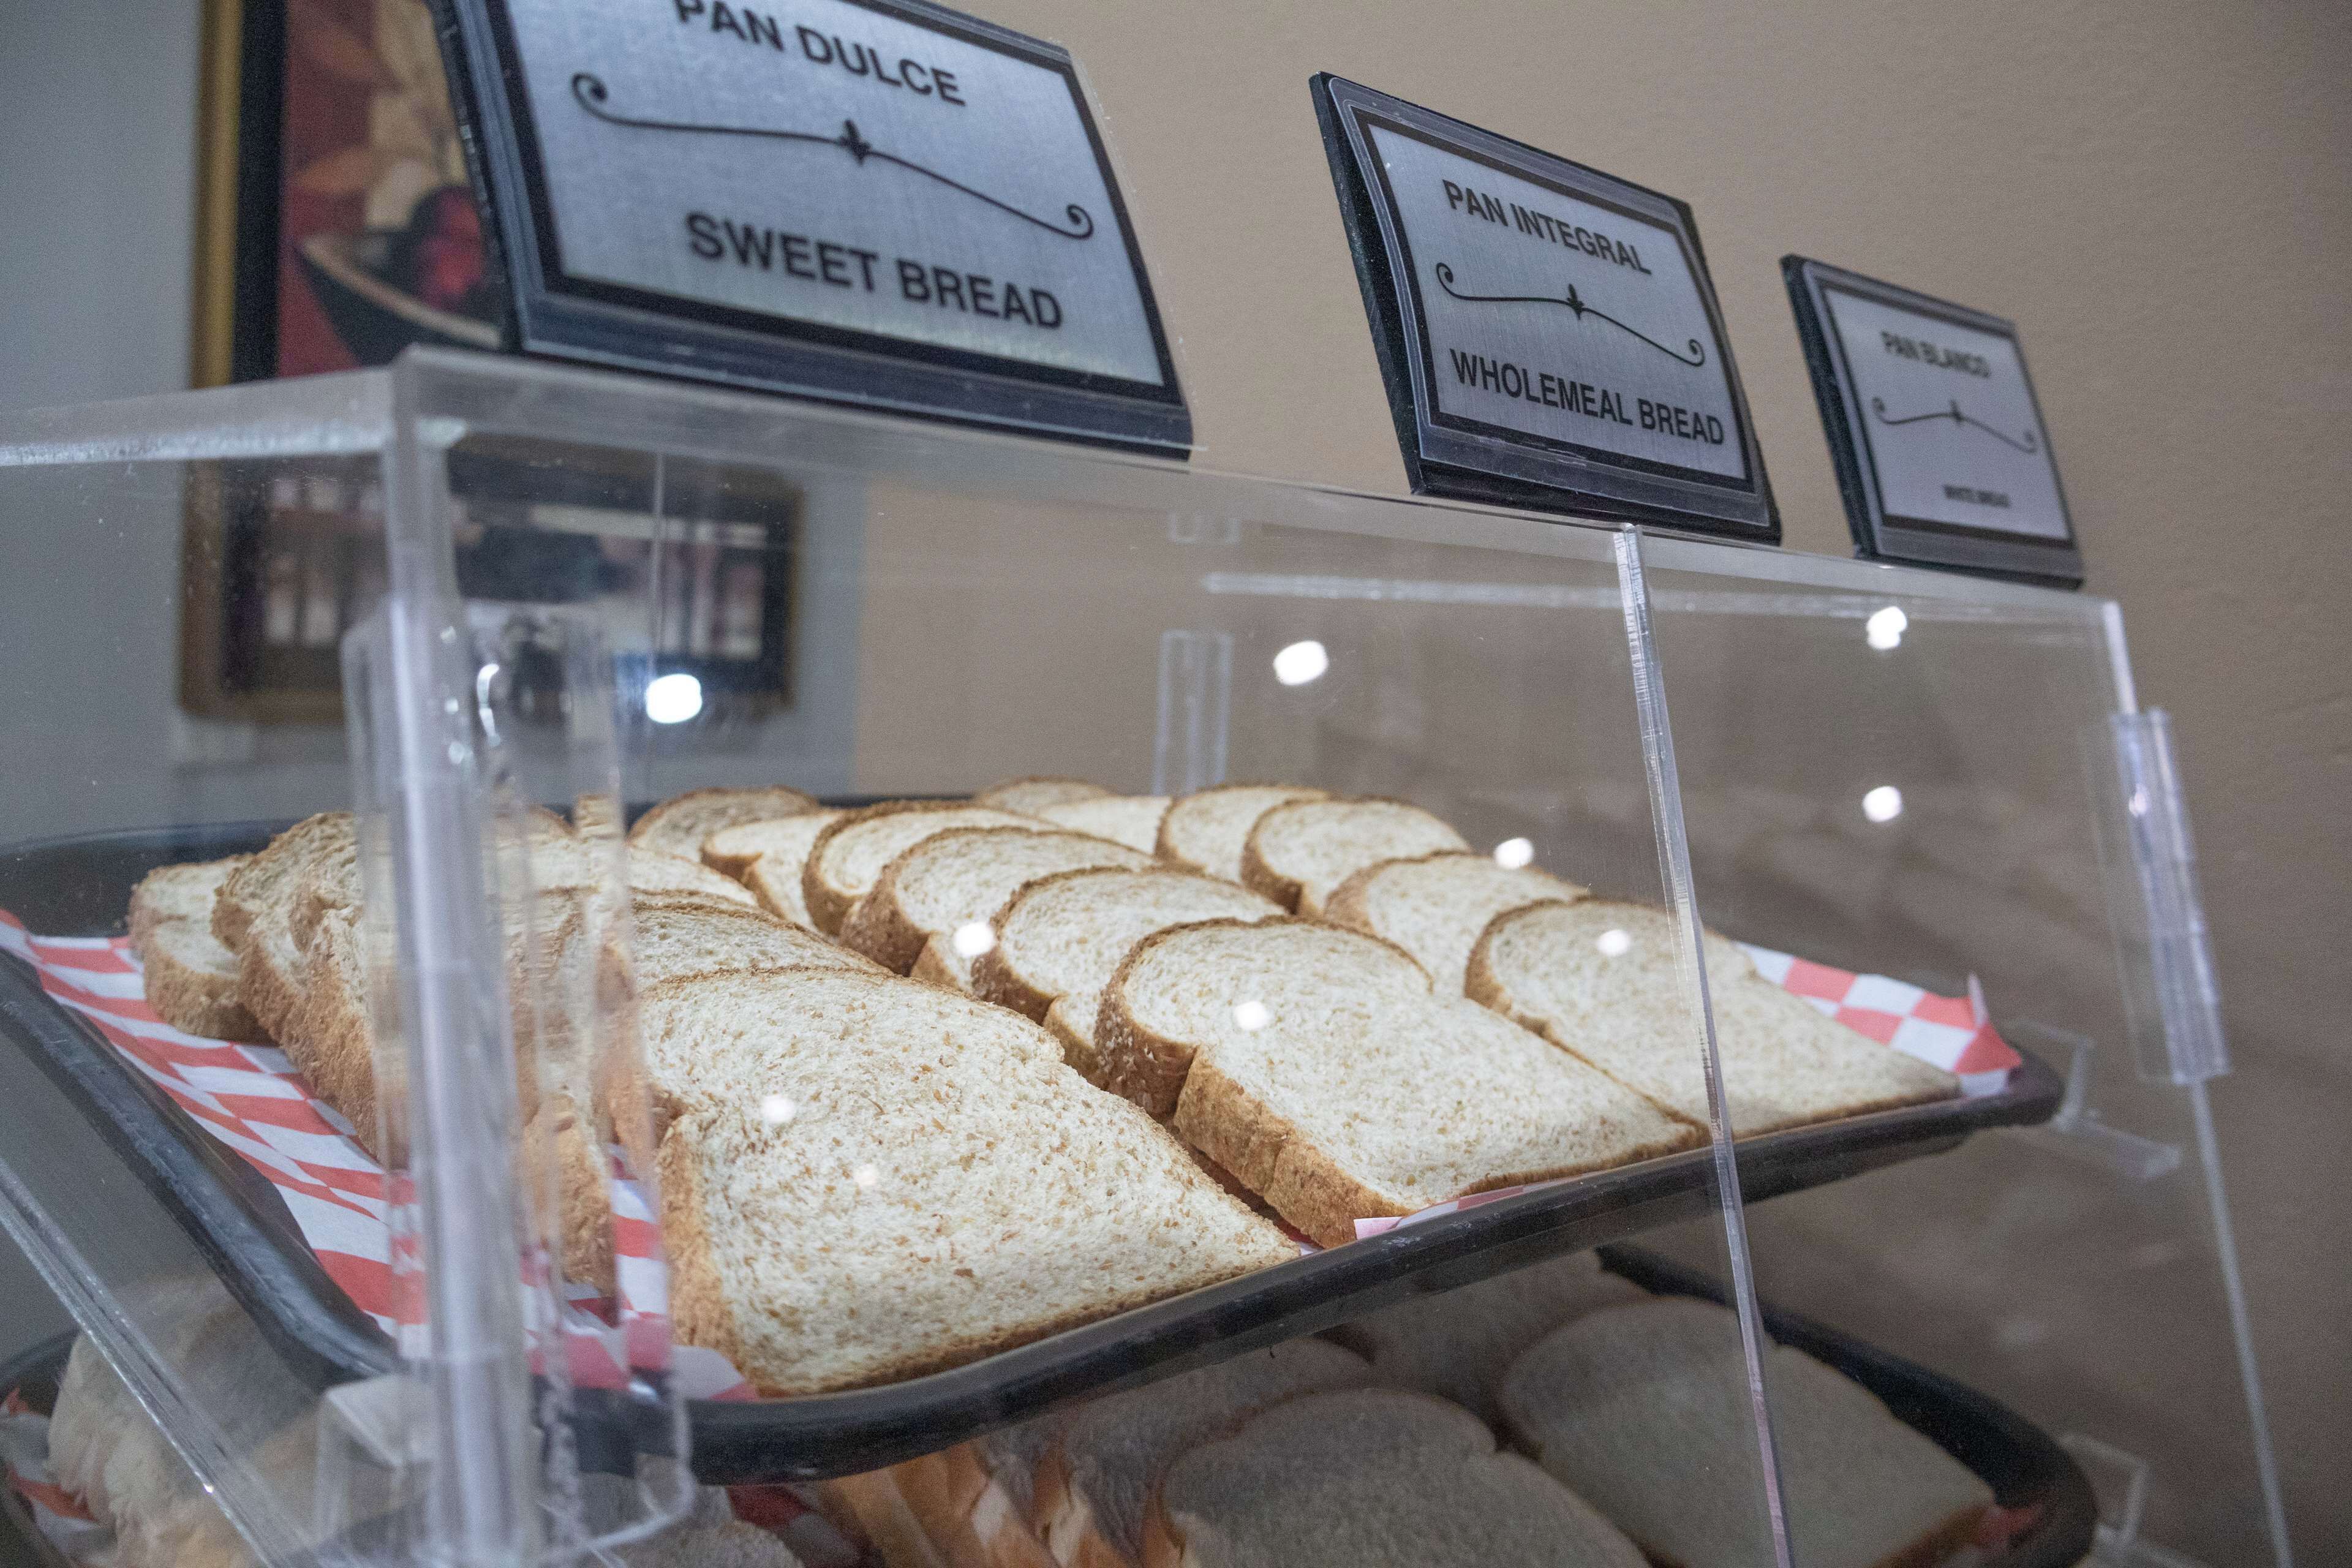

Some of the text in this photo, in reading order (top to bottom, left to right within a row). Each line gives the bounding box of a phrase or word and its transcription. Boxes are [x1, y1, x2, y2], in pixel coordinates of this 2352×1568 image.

[796, 24, 966, 107] DULCE
[685, 212, 1063, 330] SWEET BREAD
[1442, 179, 1652, 275] PAN INTEGRAL
[1450, 349, 1724, 445] WHOLEMEAL BREAD
